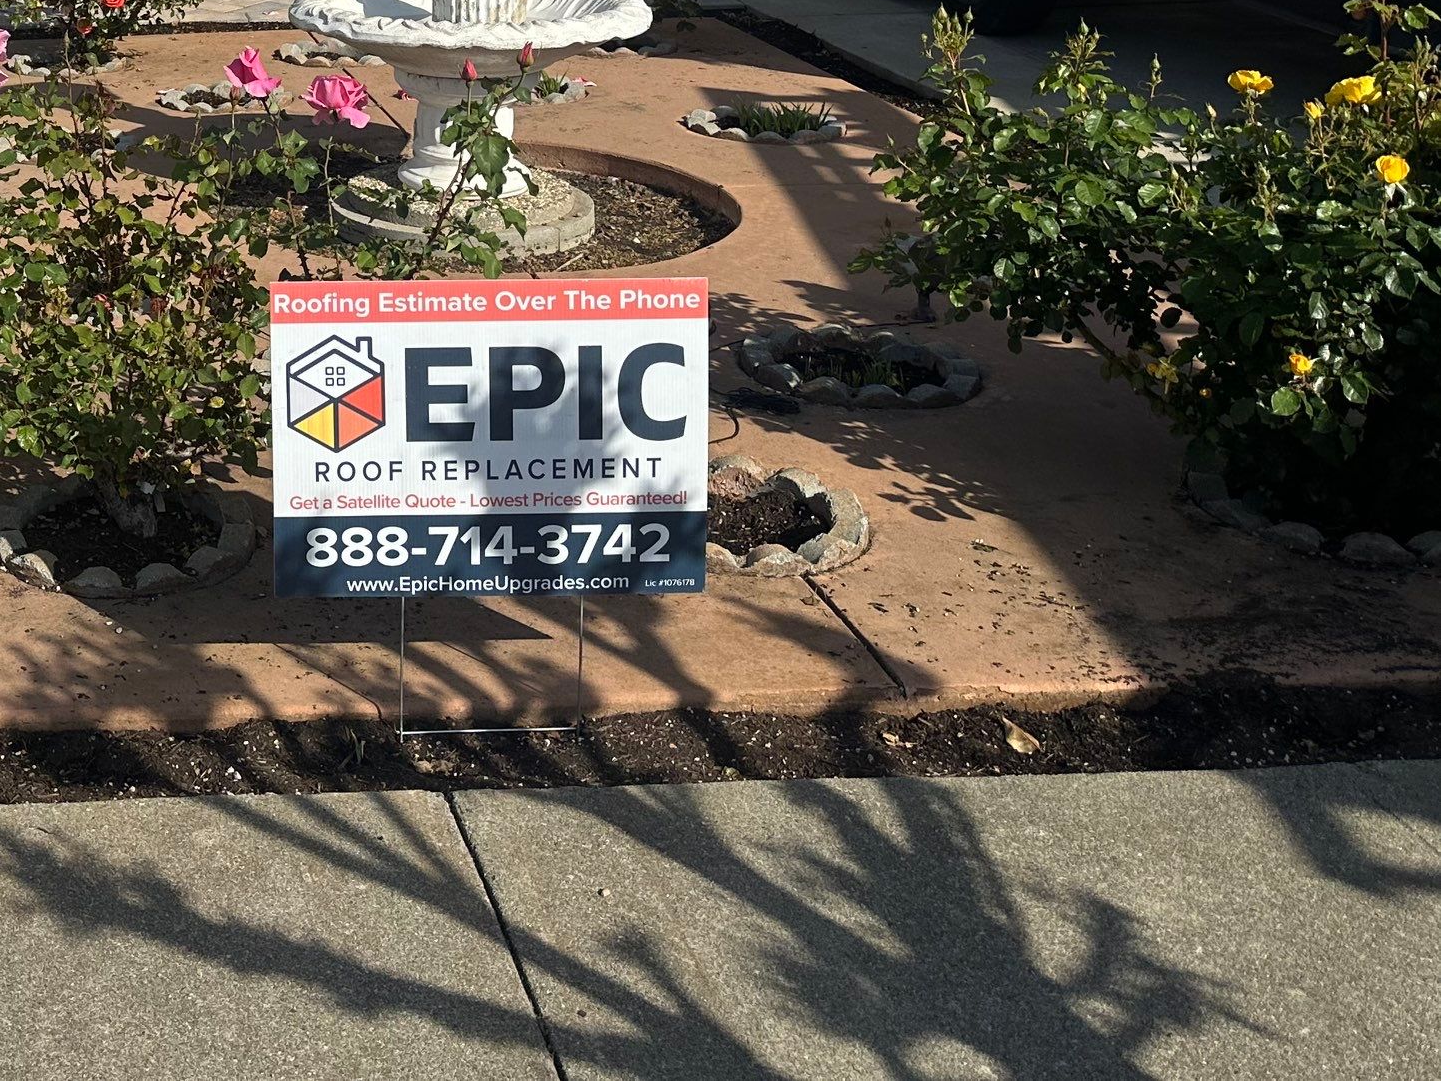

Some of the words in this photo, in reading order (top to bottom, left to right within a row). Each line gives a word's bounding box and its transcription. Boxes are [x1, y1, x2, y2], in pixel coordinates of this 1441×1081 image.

[273, 292, 370, 317] Roofing
[378, 290, 487, 313] Estimate
[495, 291, 556, 312] Over
[564, 290, 611, 310] The
[620, 287, 701, 310] Phone
[404, 343, 687, 442] EPIC
[315, 460, 403, 482] ROOF
[422, 457, 662, 480] REPLACEMENT
[290, 496, 319, 510] Get
[323, 499, 332, 509] a
[337, 494, 401, 509] Satellite
[405, 495, 456, 509] Quote
[470, 493, 529, 507] Lowest
[533, 493, 581, 507] Prices
[586, 491, 688, 506] Guaranteed!
[306, 524, 670, 567] 888-714-3742
[346, 574, 630, 595] www.EpicHomeUpgrades.com
[645, 579, 656, 587] Lic
